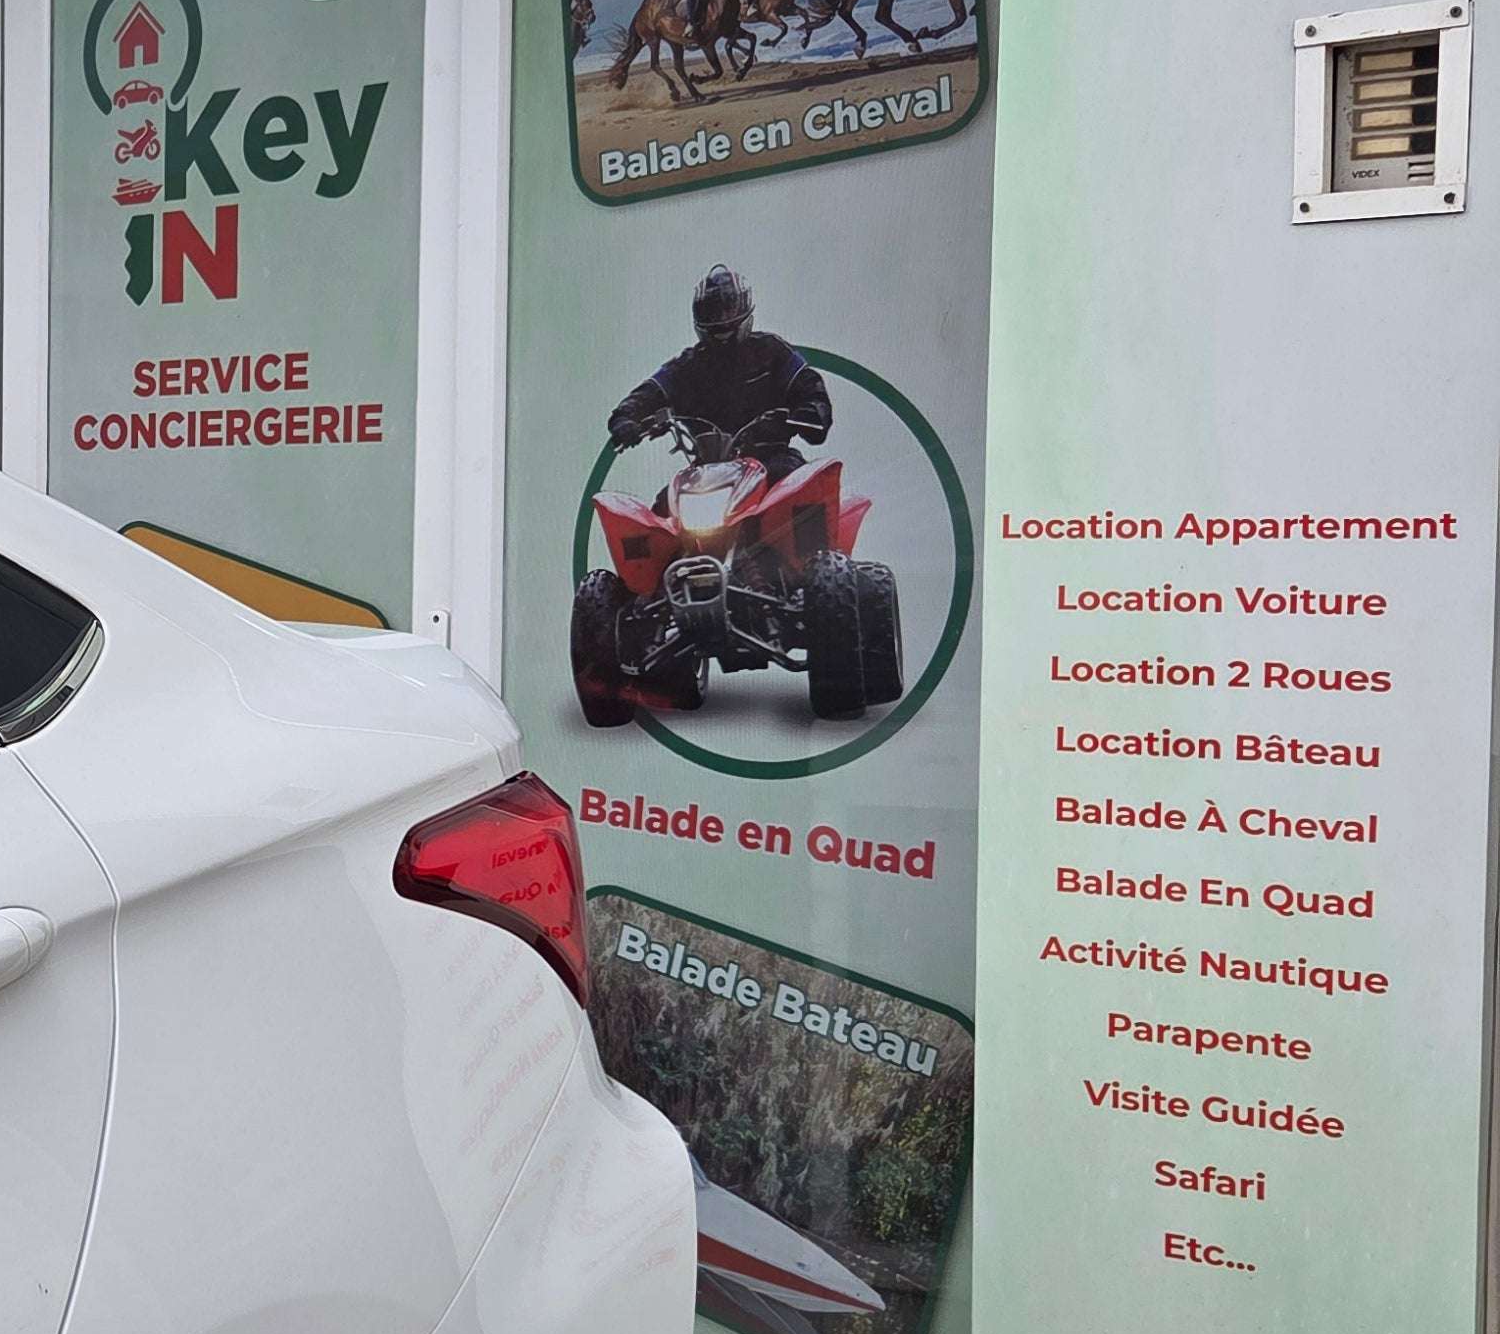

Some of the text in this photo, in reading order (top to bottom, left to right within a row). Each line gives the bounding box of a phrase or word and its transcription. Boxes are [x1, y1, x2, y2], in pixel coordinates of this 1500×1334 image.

[163, 82, 389, 203] Key
[600, 75, 953, 185] Balade en Cheval
[132, 352, 310, 398] SERVICE
[73, 403, 384, 452] CONCIERGERIE
[1002, 511, 1458, 546] Location Appartement
[1057, 584, 1387, 616] Location Voiture
[1051, 656, 1392, 693] Location 2 Roues
[1056, 727, 1380, 768] Location Bâteau
[579, 788, 936, 880] Balade en Quad
[1055, 797, 1379, 844] Balade À Cheval
[1056, 867, 1374, 918] Balade En Quad
[1040, 936, 1389, 996] Activité Nautique
[616, 924, 938, 1078] Balade Bateau
[1108, 1013, 1312, 1060] Parapente
[1083, 1080, 1345, 1139] Visite Guidée
[1154, 1160, 1266, 1201] Safari
[1164, 1233, 1256, 1272] Etc...
